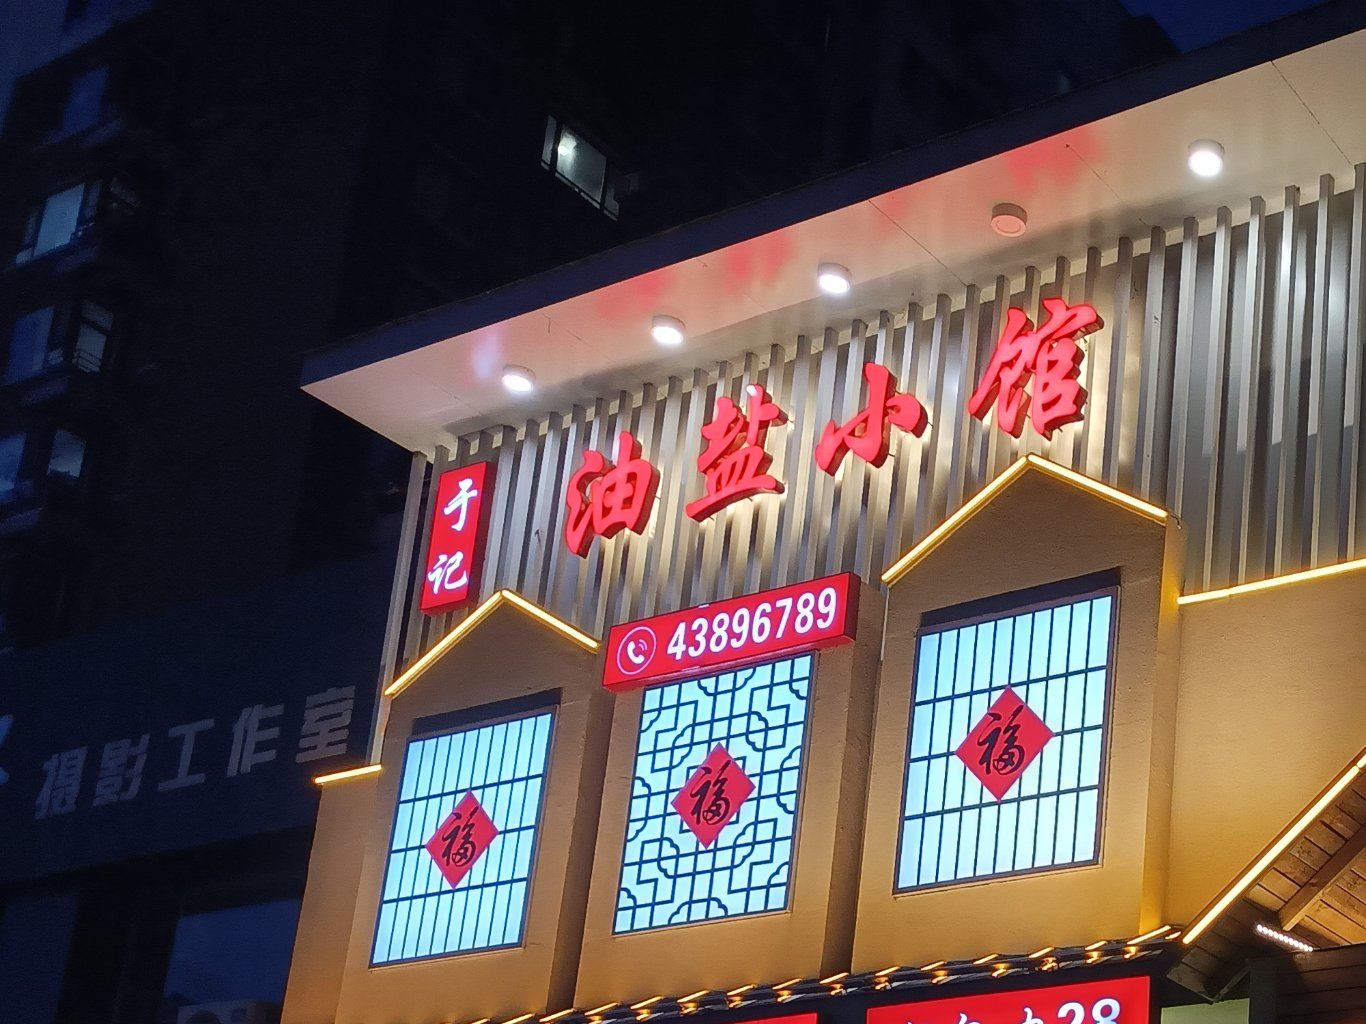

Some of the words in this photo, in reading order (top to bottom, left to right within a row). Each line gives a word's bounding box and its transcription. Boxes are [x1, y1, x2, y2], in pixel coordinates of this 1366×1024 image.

[564, 297, 1105, 558] 油盐小馆
[428, 479, 479, 595] 于记
[666, 587, 838, 662] 43896789
[978, 703, 1027, 776] 福
[690, 767, 733, 828] 福
[441, 812, 476, 868] 福
